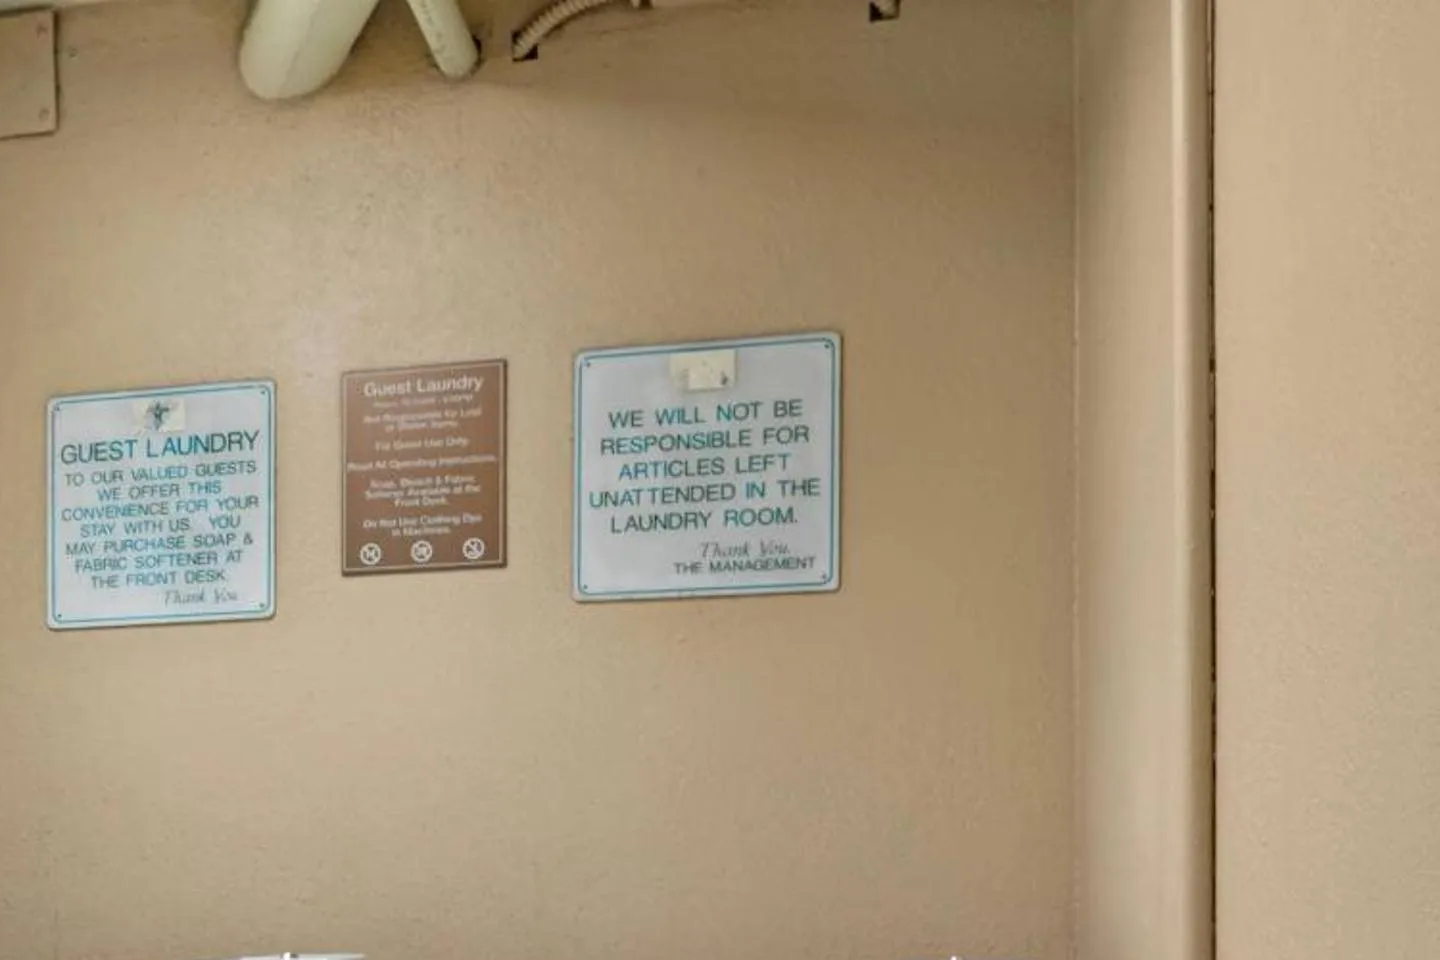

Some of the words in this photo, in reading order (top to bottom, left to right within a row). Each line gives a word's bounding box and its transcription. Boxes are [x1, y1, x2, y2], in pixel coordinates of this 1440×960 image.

[364, 379, 410, 396] Guest
[417, 376, 484, 392] Laundry
[608, 410, 644, 428] WE
[655, 406, 706, 426] WILL
[716, 402, 762, 421] NOT
[773, 399, 803, 417] BE
[61, 439, 138, 464] GUEST
[146, 430, 259, 458] LAUNDRY
[600, 429, 751, 455] RESPONSIBLE
[763, 425, 809, 445] FOR
[65, 473, 84, 486] TO
[91, 470, 124, 483] OUR
[131, 466, 188, 481] VALUED
[195, 461, 257, 476] GUESTS
[618, 457, 725, 480] ARTICLES
[735, 453, 791, 472] LEFT
[97, 487, 121, 501] WE
[128, 483, 180, 499] OFFER
[188, 480, 222, 494] THIS
[589, 483, 736, 508] UNATTENDED
[746, 482, 765, 498] IN
[777, 478, 821, 496] THE
[62, 502, 169, 521] CONVENIENCE
[176, 499, 208, 512] FOR
[217, 495, 259, 510] YOUR
[611, 511, 711, 533] LAUNDRY
[724, 507, 798, 527] ROOM.
[80, 523, 116, 537] STAY
[124, 519, 161, 535] WITH
[209, 515, 241, 529] YOU
[65, 543, 96, 555] MAY
[104, 536, 185, 552] PURCHASE
[193, 533, 236, 548] SOAP
[243, 532, 253, 545] &
[701, 541, 749, 558] Thank
[75, 558, 128, 573] FABRIC
[135, 552, 217, 569] SOFTENER
[226, 550, 243, 563] AT
[674, 562, 702, 574] THE
[710, 557, 816, 572] MANAGEMENT
[91, 575, 120, 589] THE
[126, 571, 177, 586] FRONT
